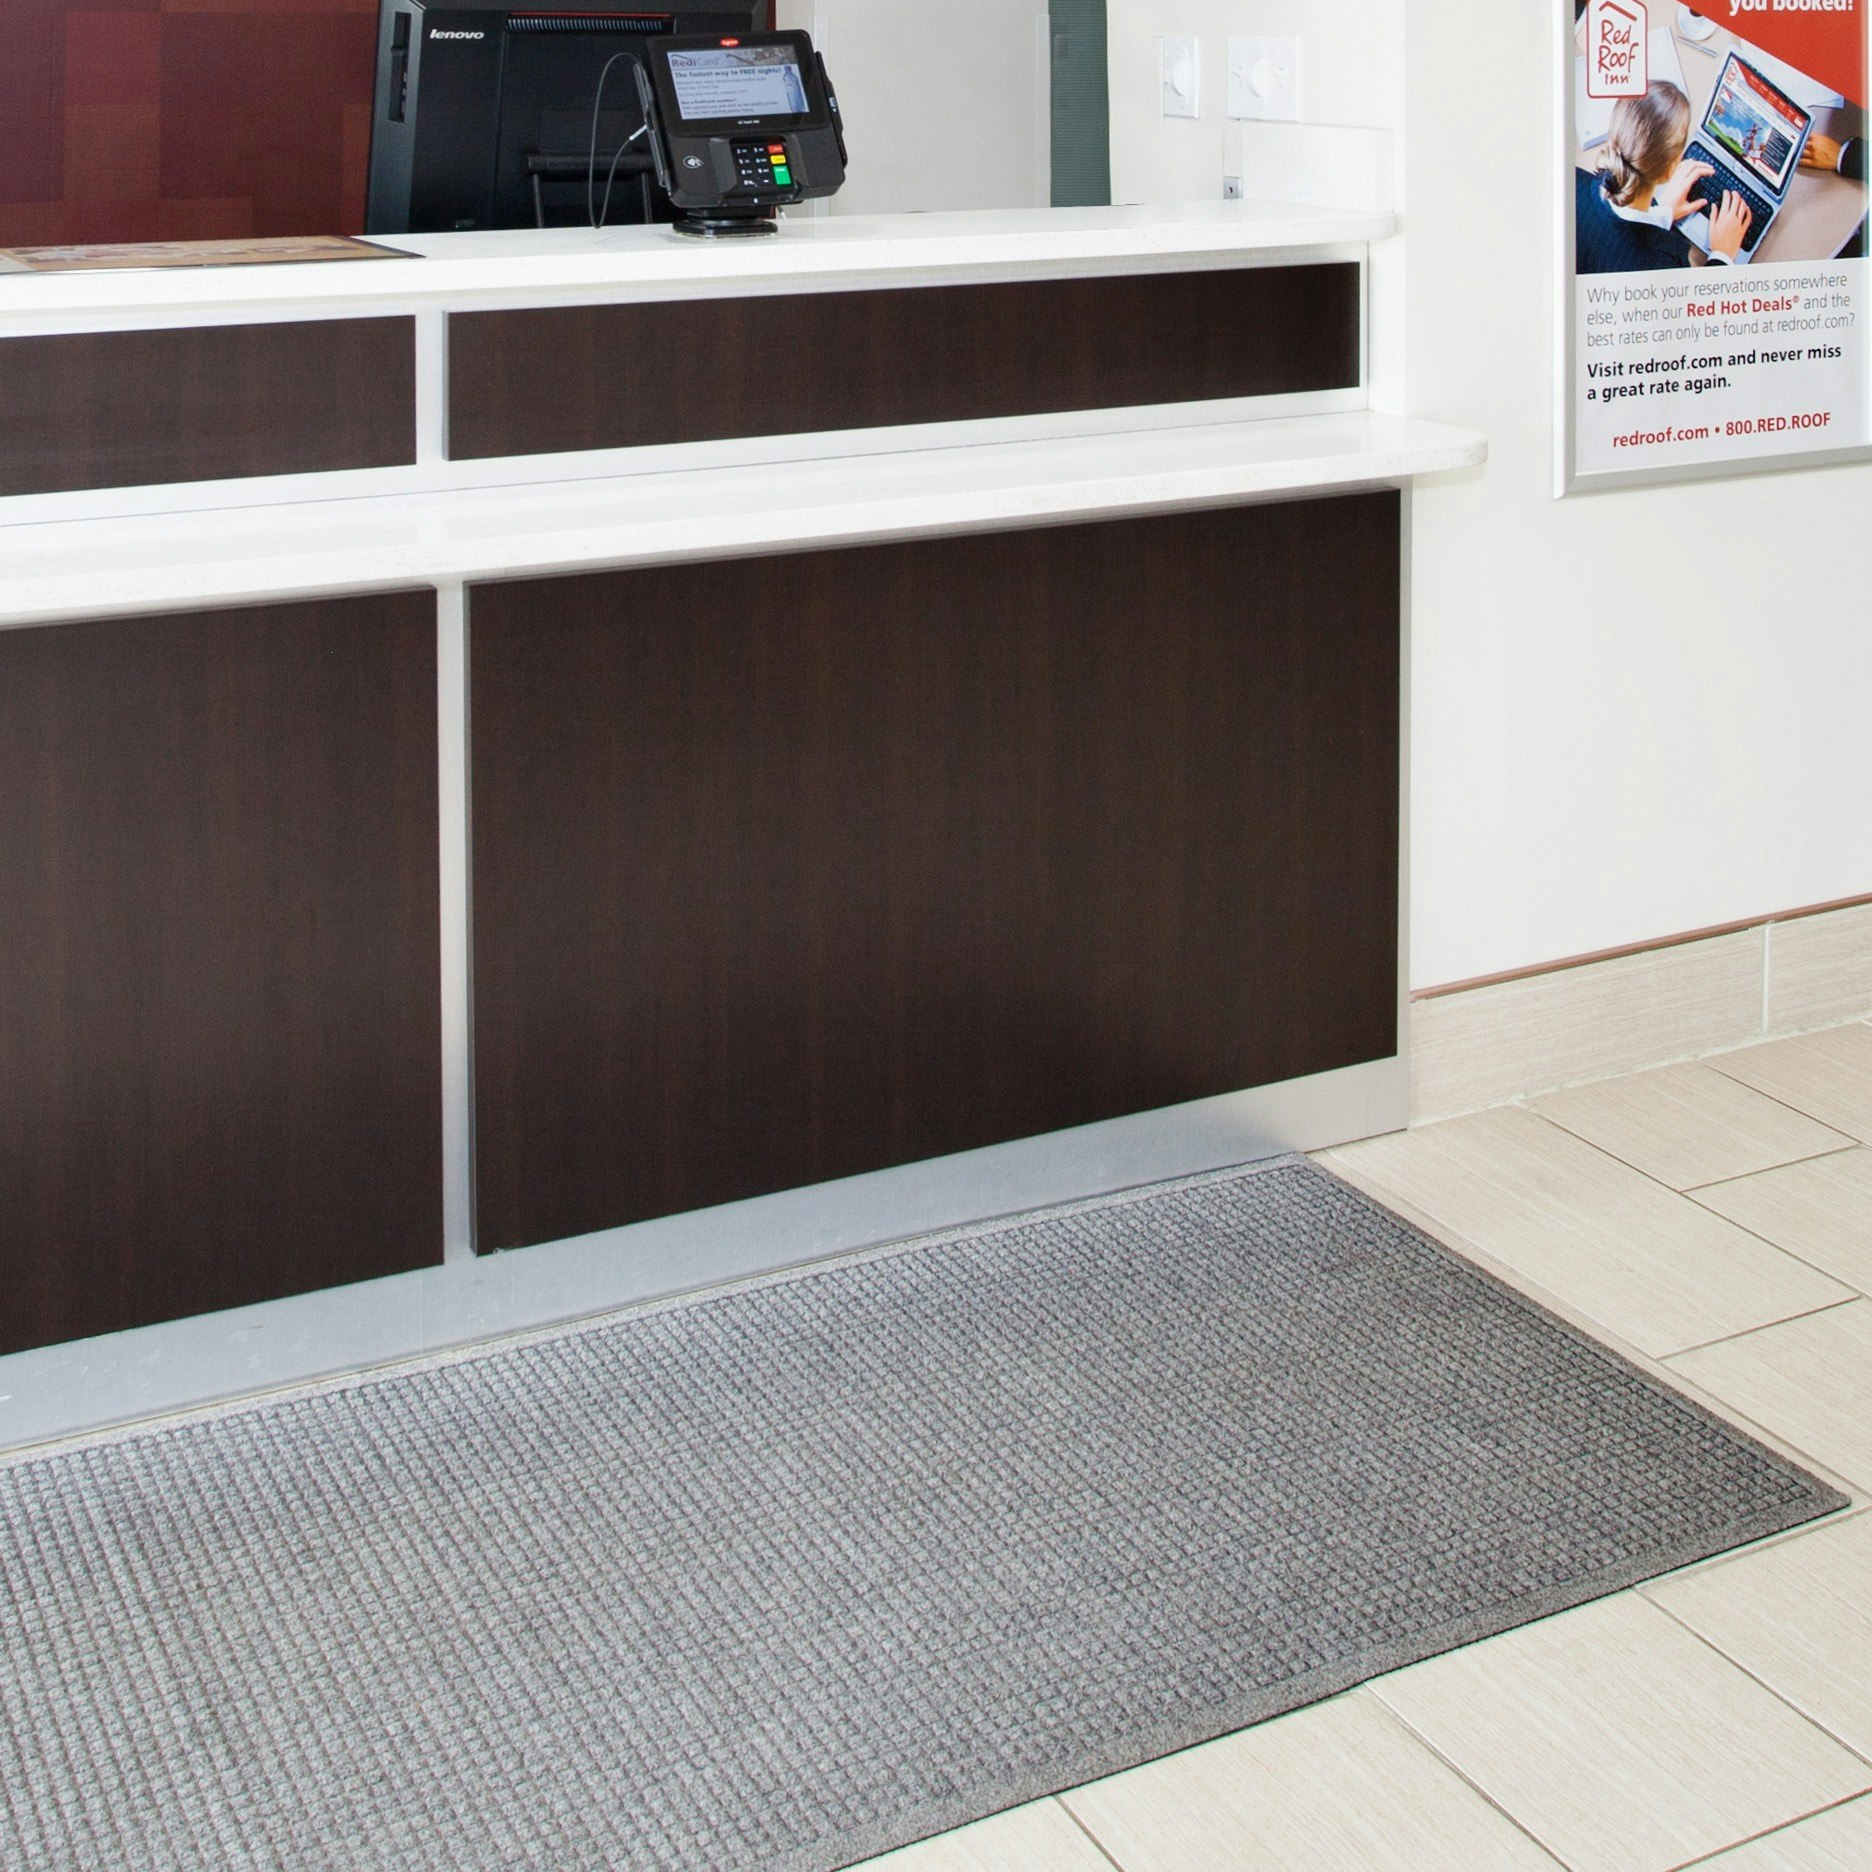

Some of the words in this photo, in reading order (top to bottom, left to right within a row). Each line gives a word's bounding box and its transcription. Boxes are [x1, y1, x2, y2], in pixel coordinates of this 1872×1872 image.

[430, 29, 484, 39] lenovo
[1600, 19, 1630, 44] Red
[1598, 43, 1638, 73] Roof
[1587, 286, 1619, 304] Why
[1625, 285, 1657, 301] book
[1661, 286, 1689, 300] your
[1694, 277, 1769, 296] reservations
[1773, 273, 1847, 291] somewhere
[1587, 308, 1617, 326] else,
[1622, 306, 1658, 322] when
[1662, 307, 1682, 320] our
[1687, 300, 1715, 317] Red
[1721, 299, 1747, 315] Hot
[1804, 294, 1827, 309] and
[1831, 292, 1850, 307] the
[1587, 331, 1613, 347] best
[1619, 329, 1648, 344] rates
[1652, 329, 1672, 342] can
[1676, 325, 1700, 343] only
[1705, 323, 1719, 337] be
[1723, 319, 1758, 336] found
[1762, 319, 1773, 333] at
[1777, 313, 1855, 332] redroof.com?
[1587, 361, 1623, 378] Visit
[1629, 354, 1722, 374] redroof.com
[1728, 347, 1756, 366] and
[1761, 348, 1802, 364] never
[1808, 343, 1841, 359] miss
[1587, 386, 1596, 400] a
[1602, 380, 1645, 402] great
[1650, 379, 1679, 395] rate
[1684, 374, 1731, 395] again.
[1613, 424, 1709, 447] redroof.com
[1726, 412, 1830, 436] 800.RED.ROOF
